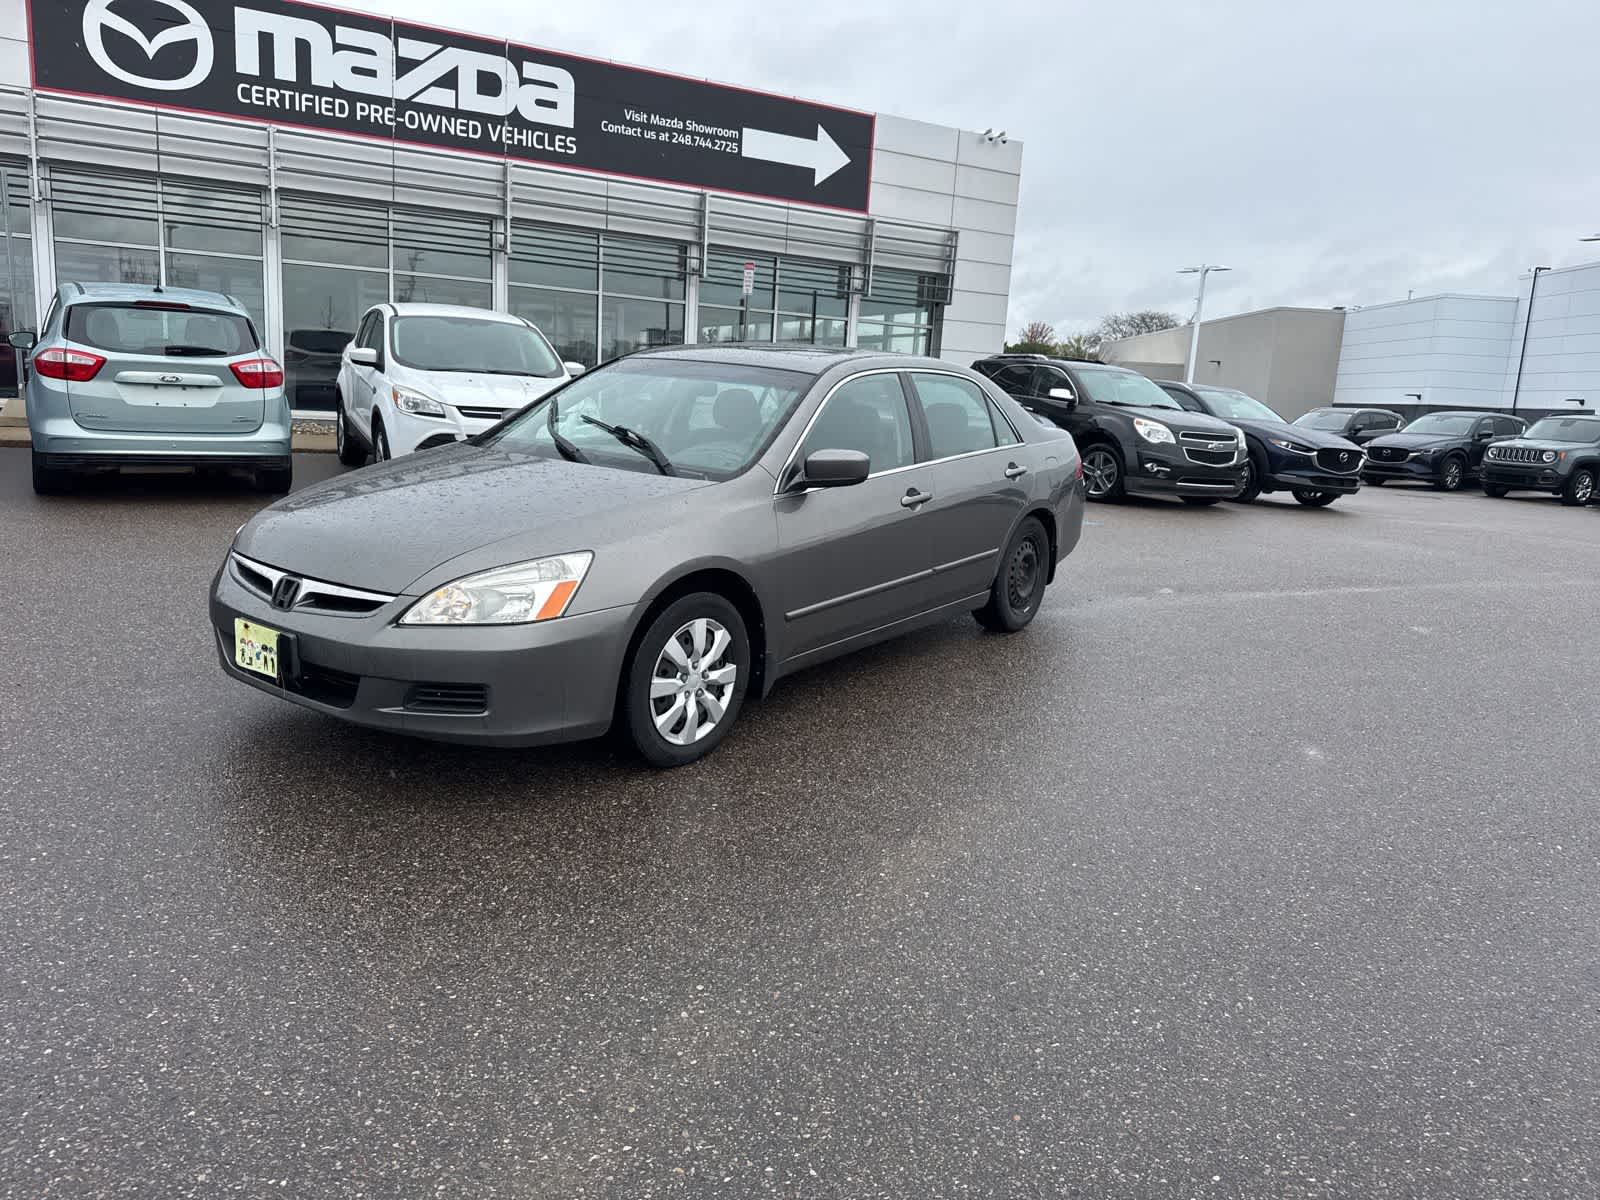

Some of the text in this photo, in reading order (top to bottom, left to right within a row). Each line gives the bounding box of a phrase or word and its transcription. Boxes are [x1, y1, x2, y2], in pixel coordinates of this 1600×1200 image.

[237, 83, 577, 154] CERTIFIED PRE-OWNED VEHICLES
[624, 108, 739, 139] Visit Mazda Showroom
[601, 120, 739, 153] Contact us at 248.744.2725
